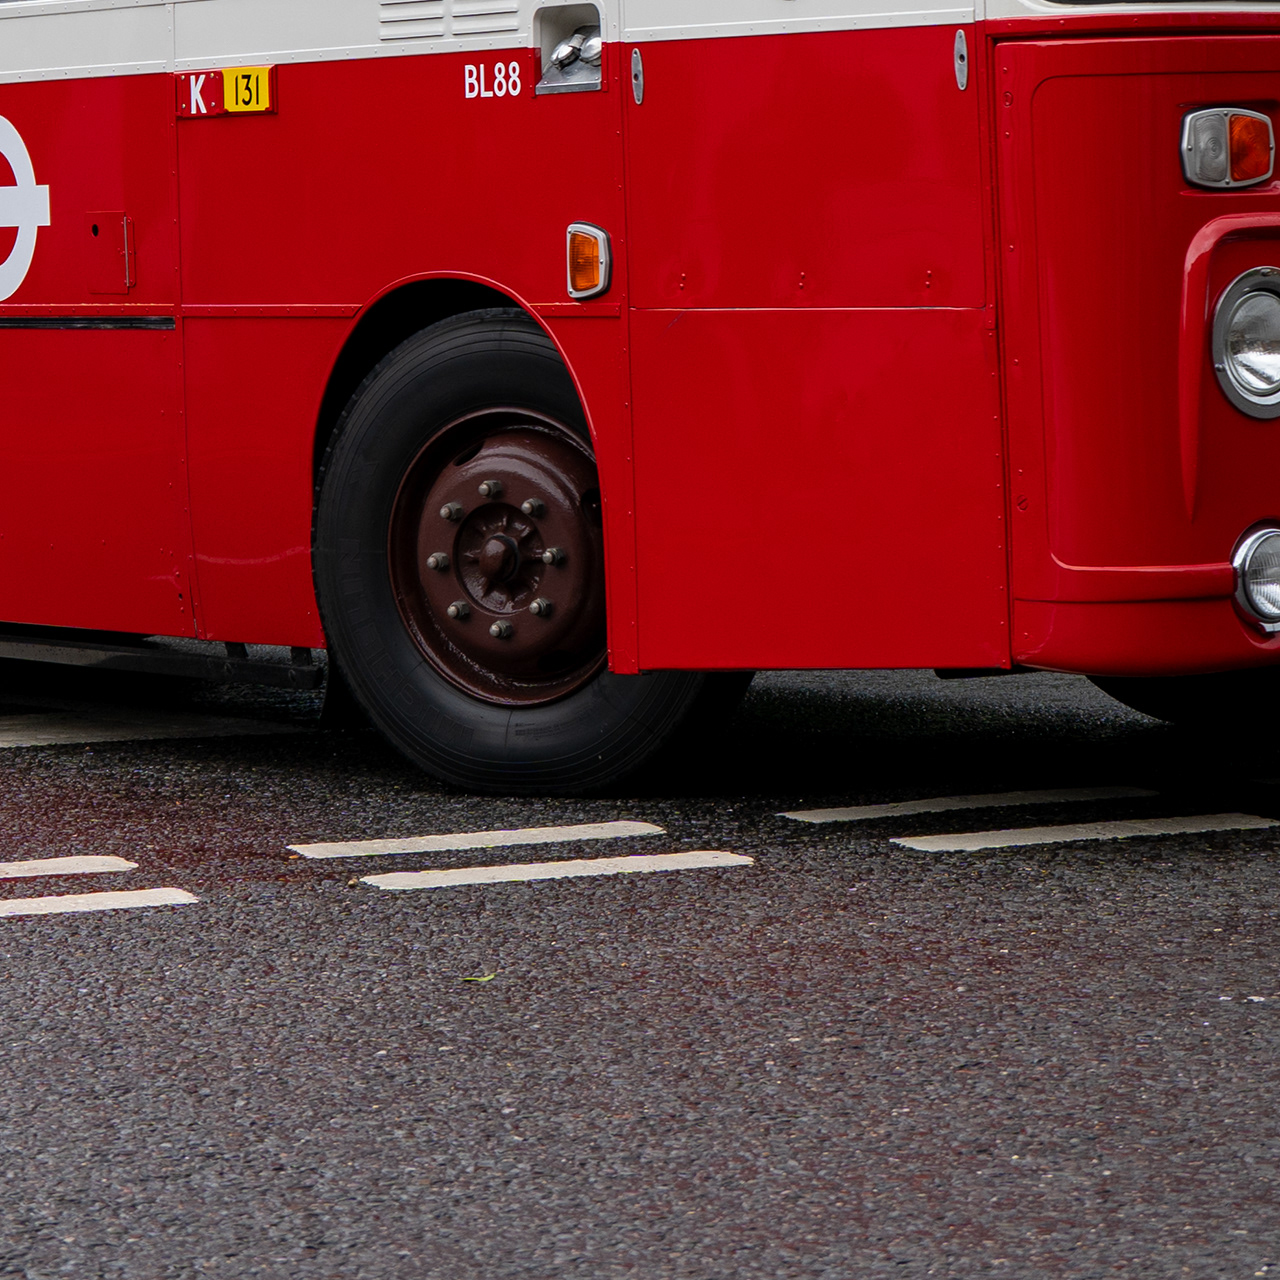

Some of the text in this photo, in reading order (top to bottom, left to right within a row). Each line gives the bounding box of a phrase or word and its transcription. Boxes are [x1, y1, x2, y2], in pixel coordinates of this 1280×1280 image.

[189, 74, 259, 114] K 131
[464, 61, 522, 99] BL88
